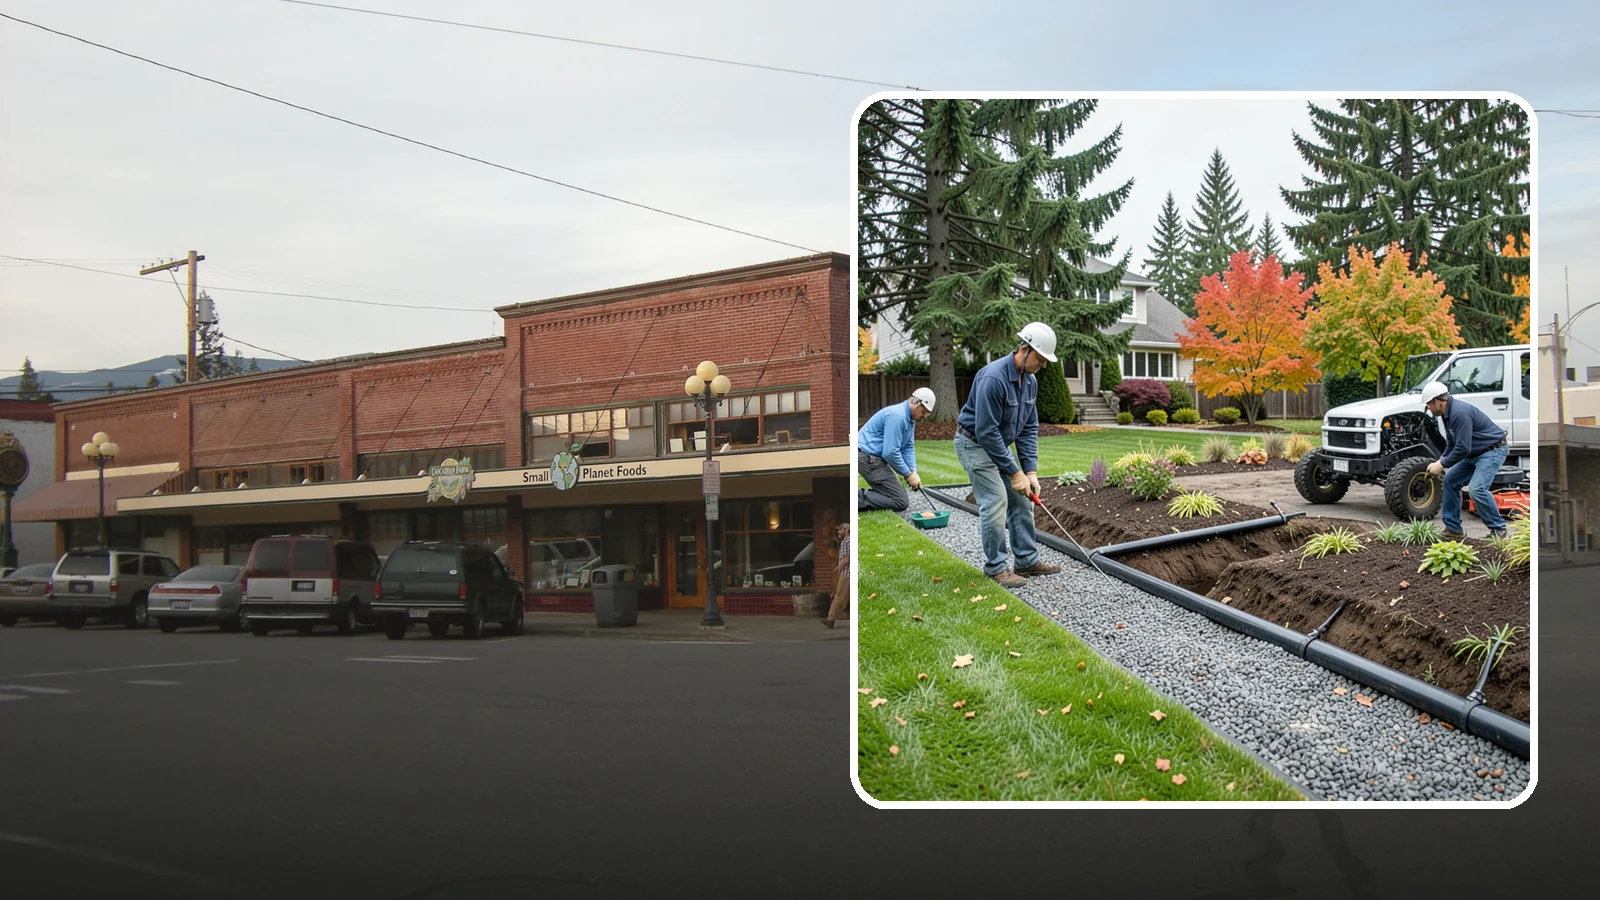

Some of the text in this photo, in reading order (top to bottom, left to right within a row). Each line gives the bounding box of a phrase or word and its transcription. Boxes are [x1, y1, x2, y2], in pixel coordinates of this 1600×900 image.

[523, 464, 647, 483] Small Planet Foods
